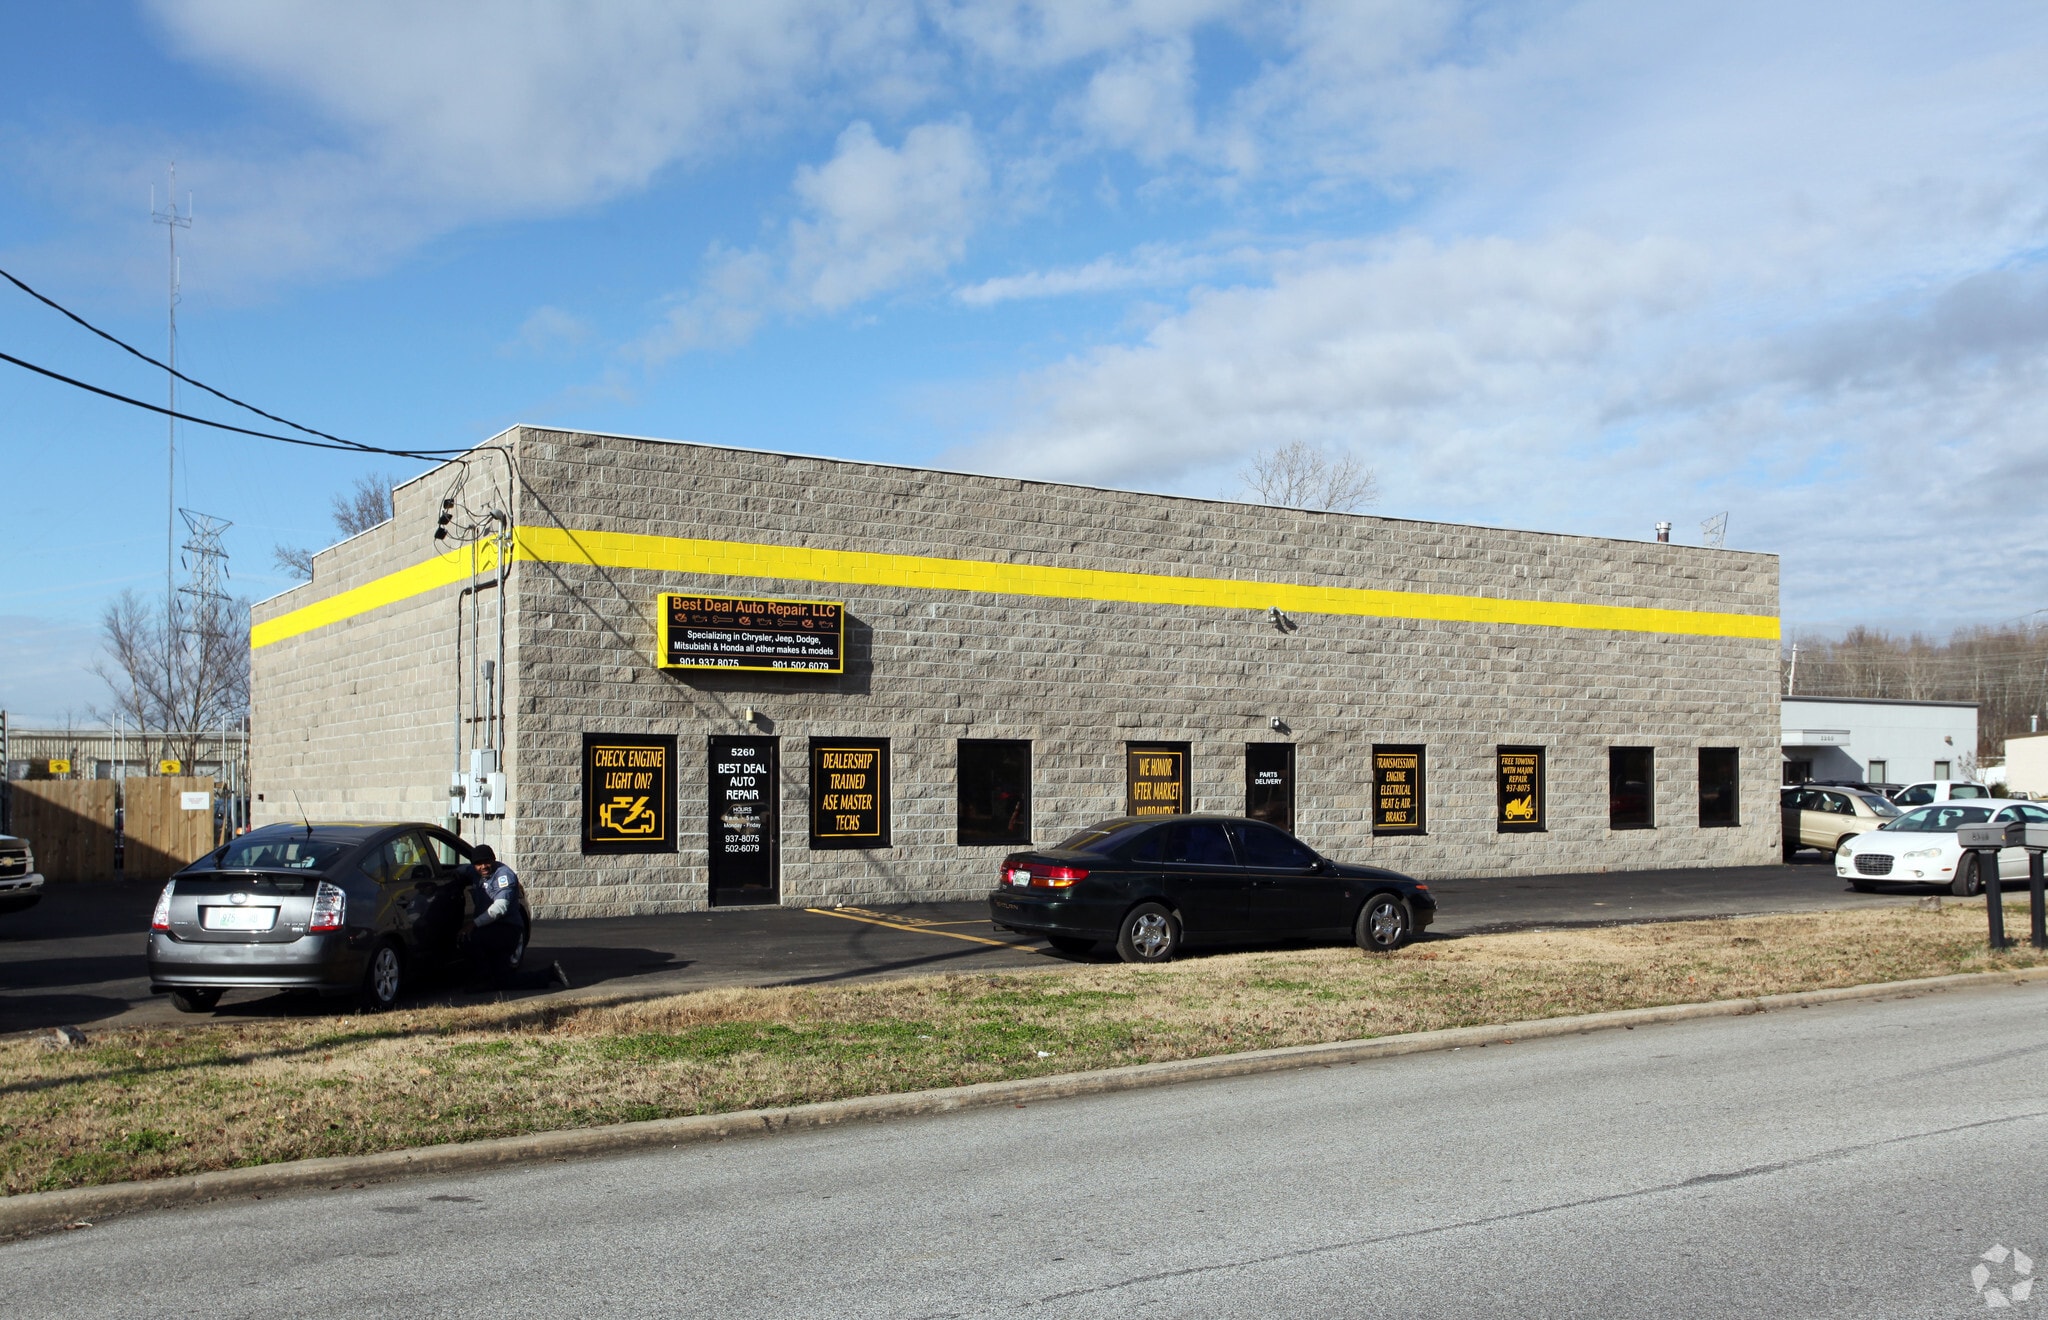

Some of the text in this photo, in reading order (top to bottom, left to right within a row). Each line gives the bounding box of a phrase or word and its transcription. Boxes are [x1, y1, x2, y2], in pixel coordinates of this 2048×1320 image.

[672, 597, 702, 611] Best
[704, 599, 733, 613] Deal
[735, 600, 765, 614] Auto
[812, 604, 836, 617] LLC
[687, 630, 821, 646] Specializing in Chrysler, Jeep, Dodge,
[674, 641, 834, 656] Mitsubishi & Honda all other makes & models
[680, 657, 739, 667] 9019378075
[772, 660, 829, 670] 9015026079
[731, 748, 755, 757] 5260
[595, 750, 663, 768] CHECK ENGINE
[823, 753, 873, 769] DEALERSHIP
[1376, 757, 1417, 769] TRANSMISSION
[1501, 757, 1536, 766] FREE TOWING
[718, 763, 767, 774] BEST DEAL
[1139, 758, 1173, 777] WE HONOR
[1502, 766, 1534, 775] WITH MAJOR
[605, 772, 653, 790] LIGHT ON?
[730, 776, 756, 787] AUTO
[830, 773, 866, 790] TRAINED
[1385, 771, 1406, 782] ENGINE
[1508, 775, 1528, 783] REPAIR
[726, 789, 759, 800] REPAIR
[1153, 781, 1180, 800] MARKET
[1380, 784, 1412, 796] ELECTRICAL
[1505, 784, 1531, 793] 937-8075
[822, 794, 873, 810] ASE MASTER
[1380, 798, 1411, 810] HEAT & AIR
[835, 814, 860, 831] TECHS
[1385, 811, 1407, 823] BRAKES
[725, 834, 760, 843] 937-8075
[725, 844, 760, 853] 502-6079
